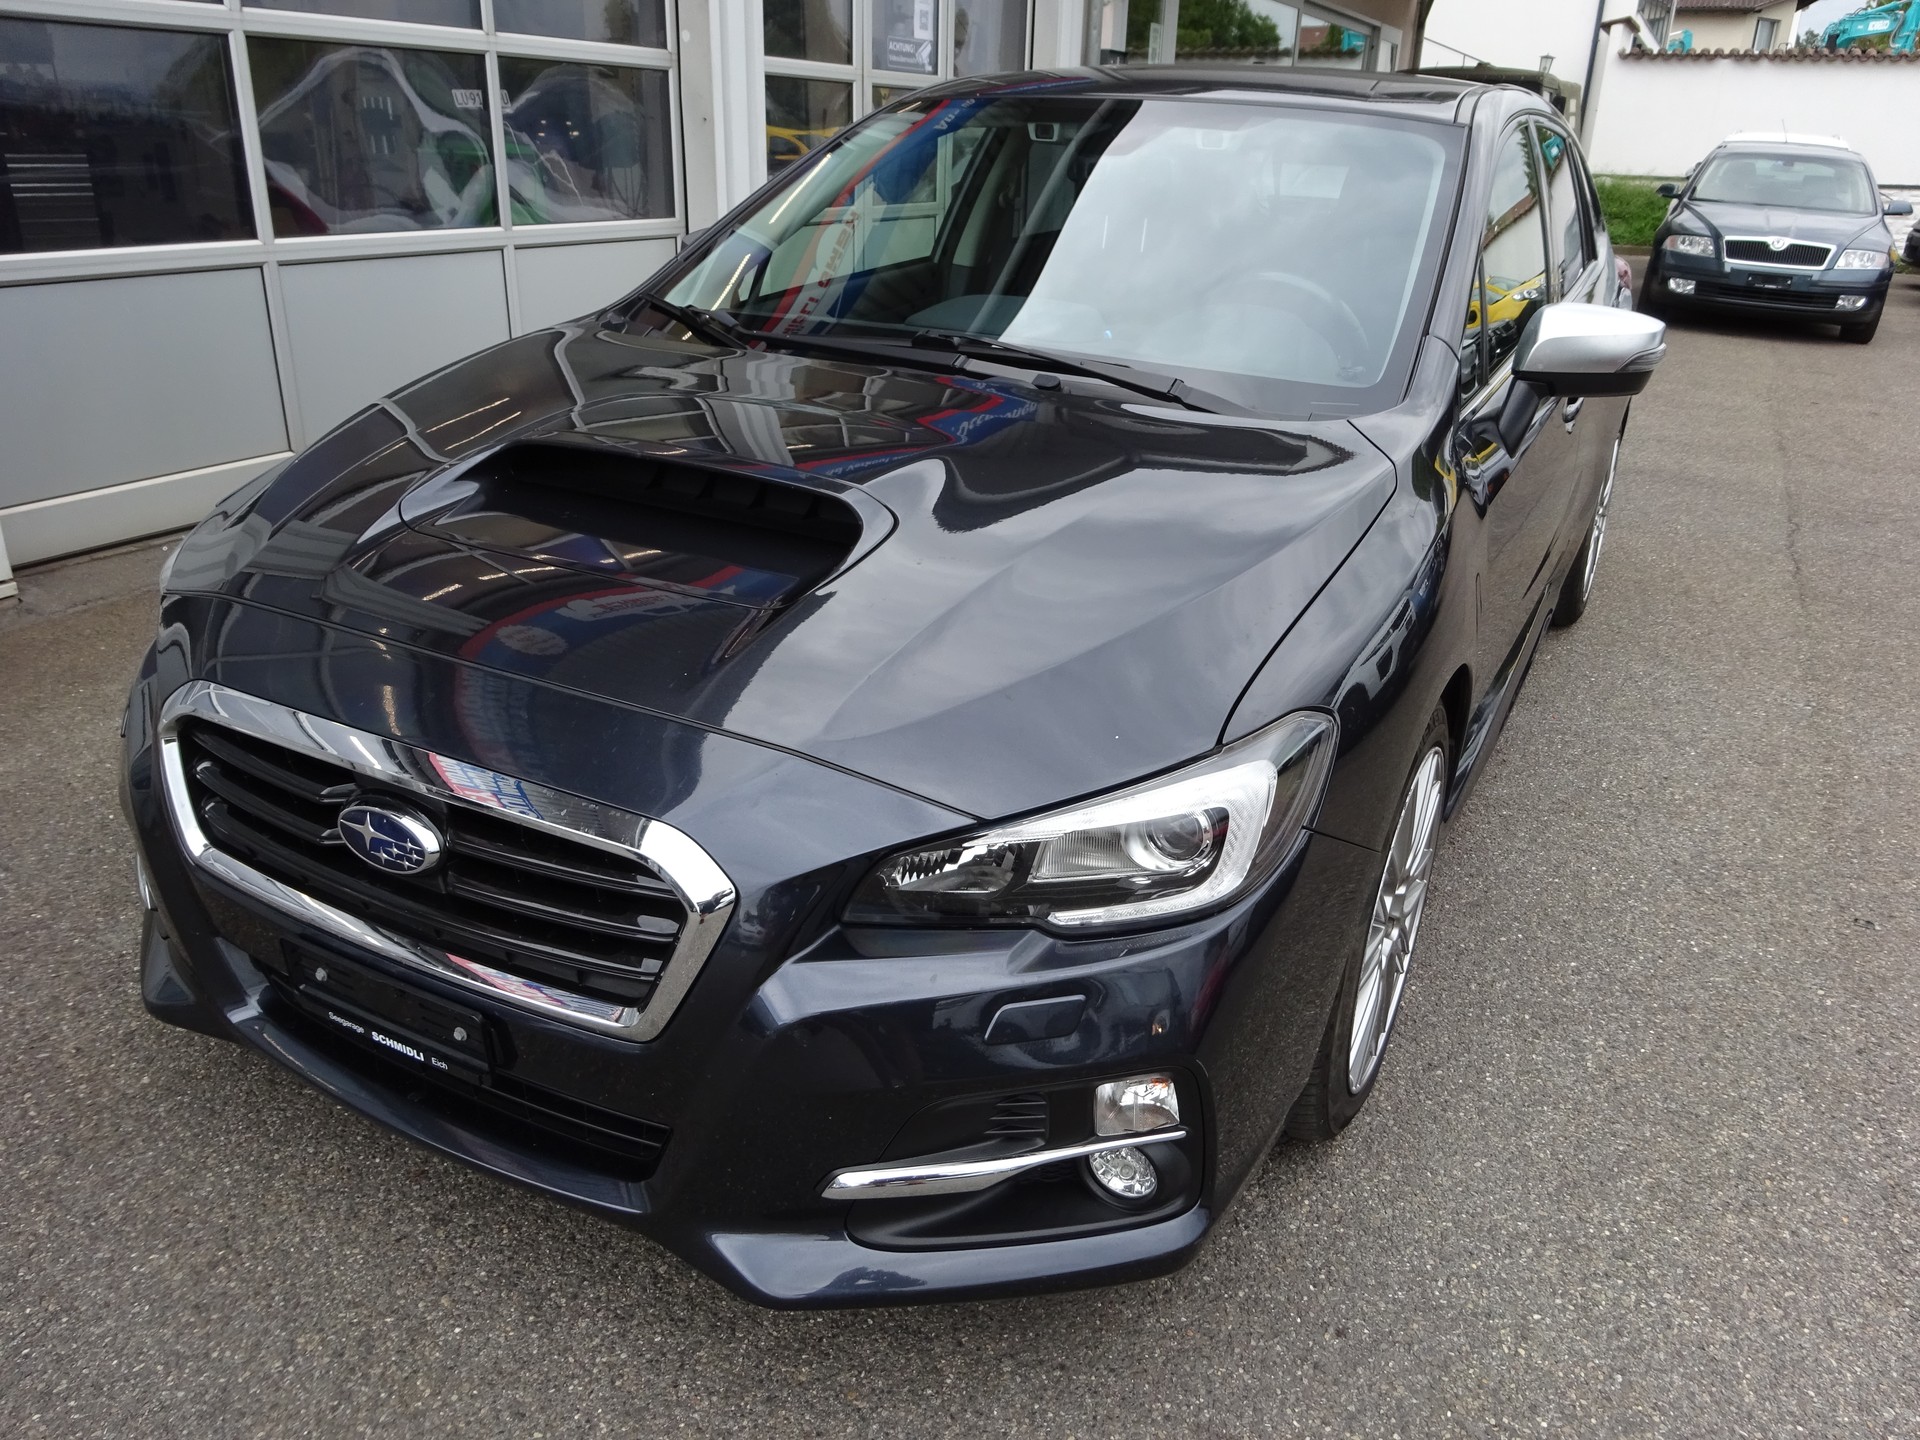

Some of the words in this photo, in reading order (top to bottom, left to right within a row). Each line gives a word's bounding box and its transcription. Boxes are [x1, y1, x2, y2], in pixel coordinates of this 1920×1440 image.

[328, 1011, 365, 1034] Seegarage
[371, 1031, 425, 1062] SCHMIDLI
[431, 1057, 449, 1070] Eich
